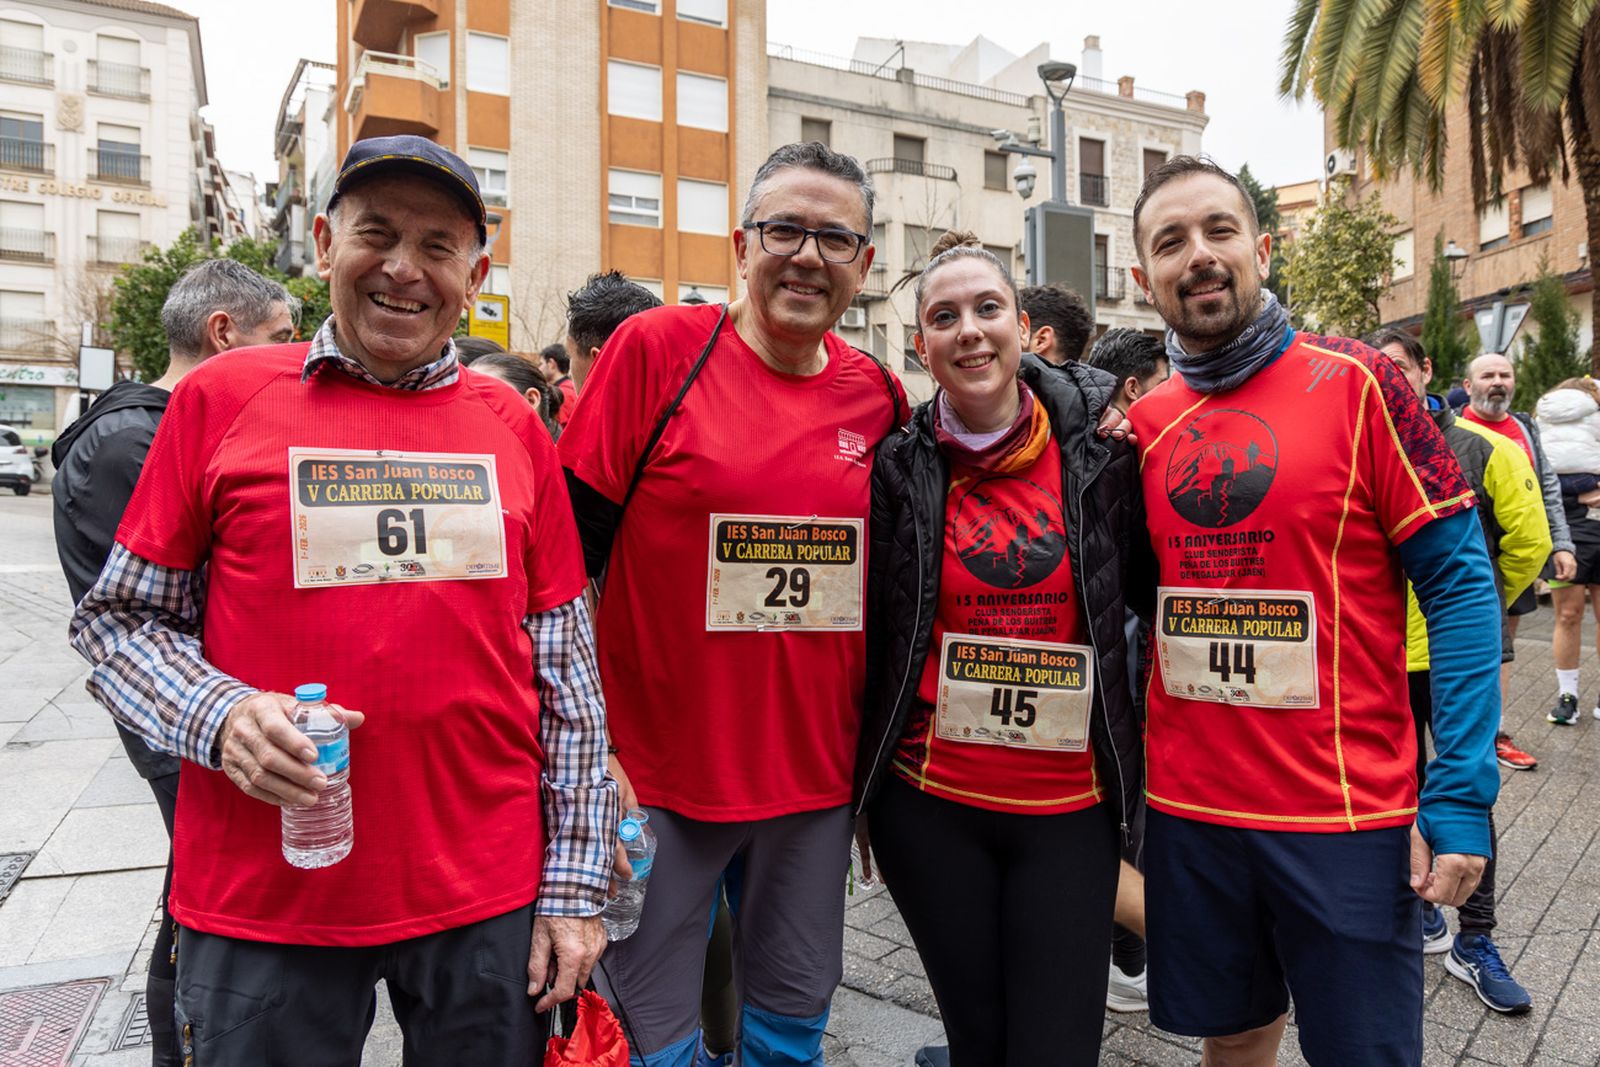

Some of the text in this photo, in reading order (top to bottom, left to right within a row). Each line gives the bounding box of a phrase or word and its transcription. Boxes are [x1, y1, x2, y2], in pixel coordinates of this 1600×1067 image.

[38, 180, 102, 201] COLEGIO
[112, 190, 168, 208] OFICIAL
[312, 464, 476, 481] IES San Juan Bosco
[307, 483, 484, 502] V CARRERA POPULAR
[377, 508, 427, 556] 61
[727, 525, 847, 541] IES San Juan Bosco
[1185, 530, 1275, 548] ANIVERSARIO
[722, 542, 851, 561] V CARRERA POPULAR
[1184, 547, 1259, 559] CLUB SENDERISTA
[1200, 560, 1211, 568] DE
[1213, 559, 1229, 568] LOS
[1230, 557, 1265, 567] BUITRES
[764, 567, 810, 608] 29
[977, 592, 1069, 606] ANIVERSARIO
[1173, 600, 1298, 616] IES San Juan Bosco
[975, 607, 1051, 617] CLUB SENDERISTA
[992, 617, 1003, 625] DE
[1006, 617, 1022, 626] LOS
[1168, 616, 1302, 638] V CARRERA POPULAR
[957, 646, 1077, 668] IES San Juan Bosco
[1209, 641, 1256, 684] 44
[952, 662, 1081, 687] V CARRERA POPULAR
[990, 687, 1038, 728] 45
